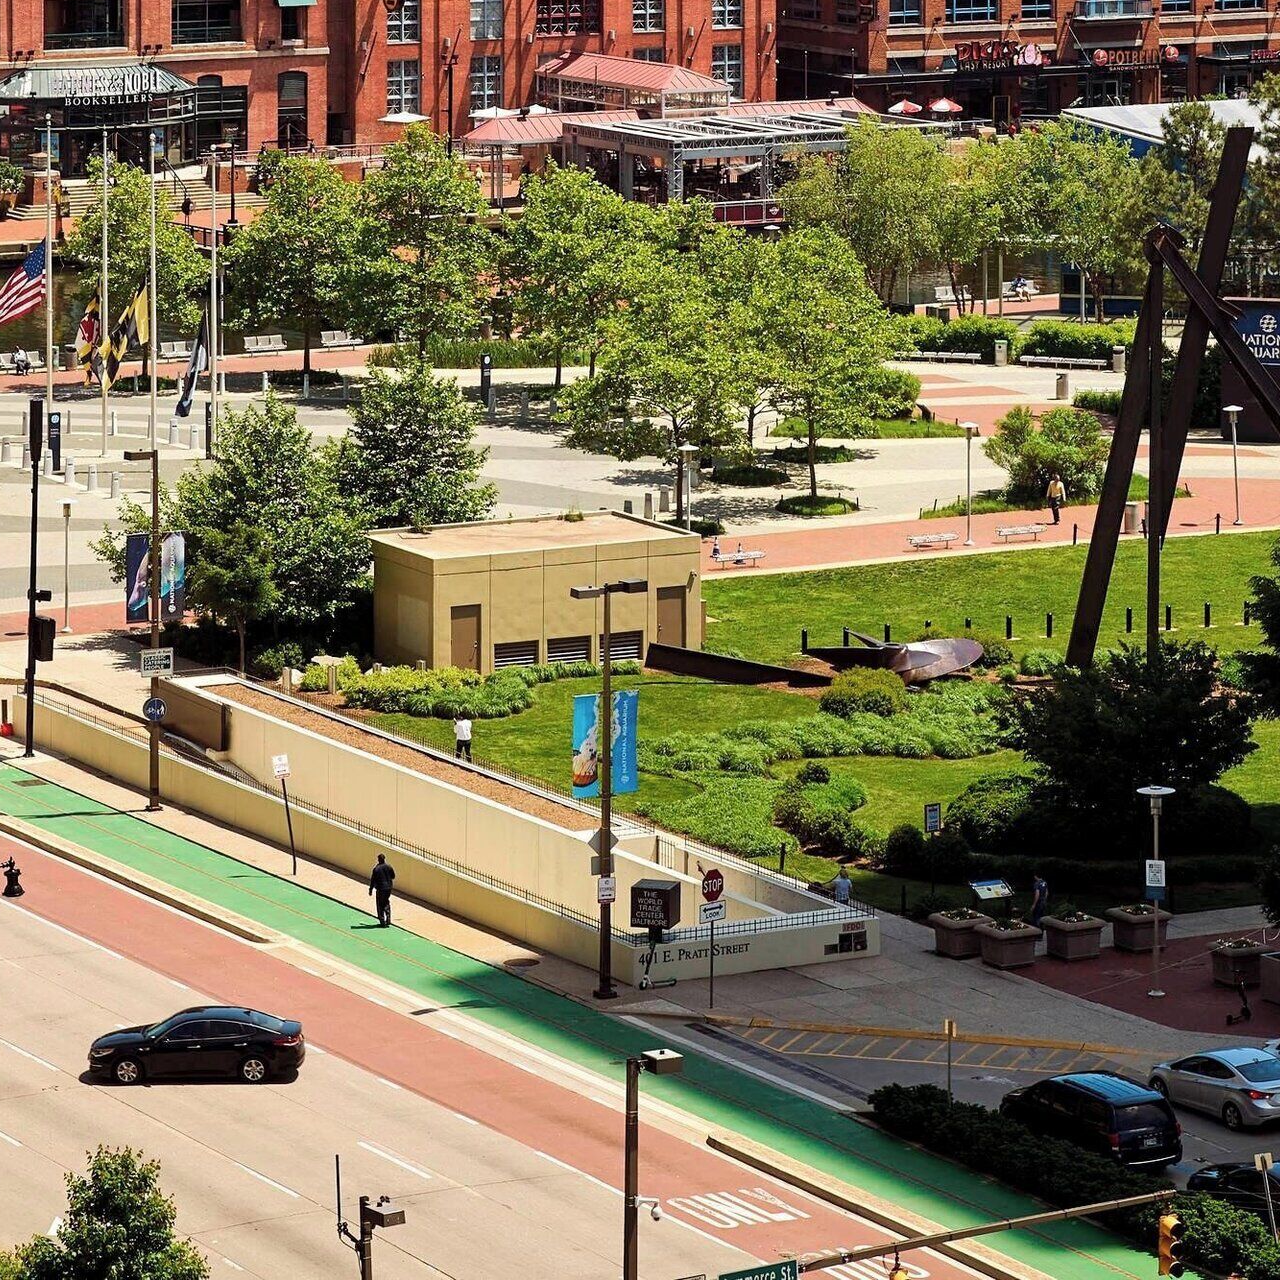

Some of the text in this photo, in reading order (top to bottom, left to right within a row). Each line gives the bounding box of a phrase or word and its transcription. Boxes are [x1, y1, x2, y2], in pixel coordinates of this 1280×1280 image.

[1109, 49, 1163, 65] POTBELLY
[960, 60, 1010, 71] LAST RESORT
[65, 94, 153, 106] BOOKSELLERS
[703, 879, 722, 894] STOP
[632, 918, 668, 926] BALTIMORE
[663, 952, 674, 963] E.
[678, 948, 710, 961] PRATT
[712, 943, 750, 956] STREET
[666, 1187, 812, 1229] ONLY
